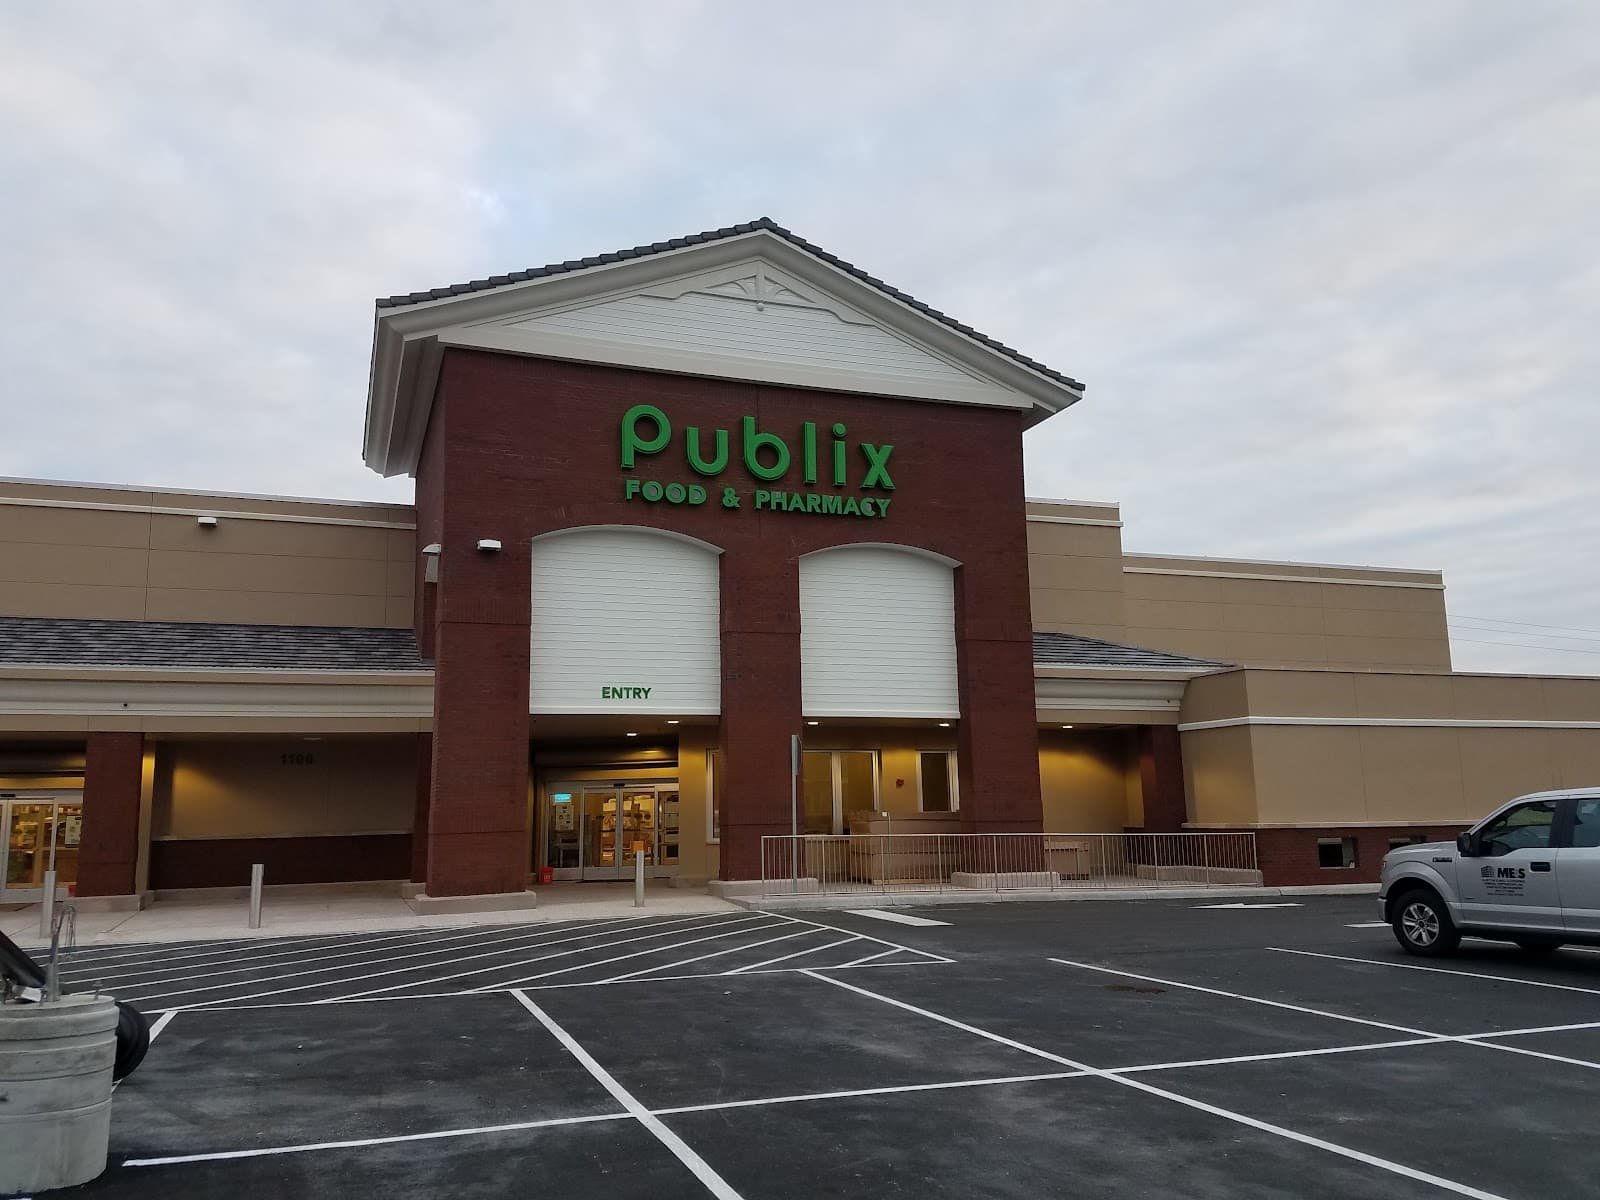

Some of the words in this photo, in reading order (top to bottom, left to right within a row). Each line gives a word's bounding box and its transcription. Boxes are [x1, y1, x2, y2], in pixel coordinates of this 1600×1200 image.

[621, 404, 896, 490] Publix
[625, 479, 707, 505] FOOD
[722, 487, 740, 508] &
[755, 489, 892, 518] PHARMACY
[601, 686, 652, 700] ENTRY
